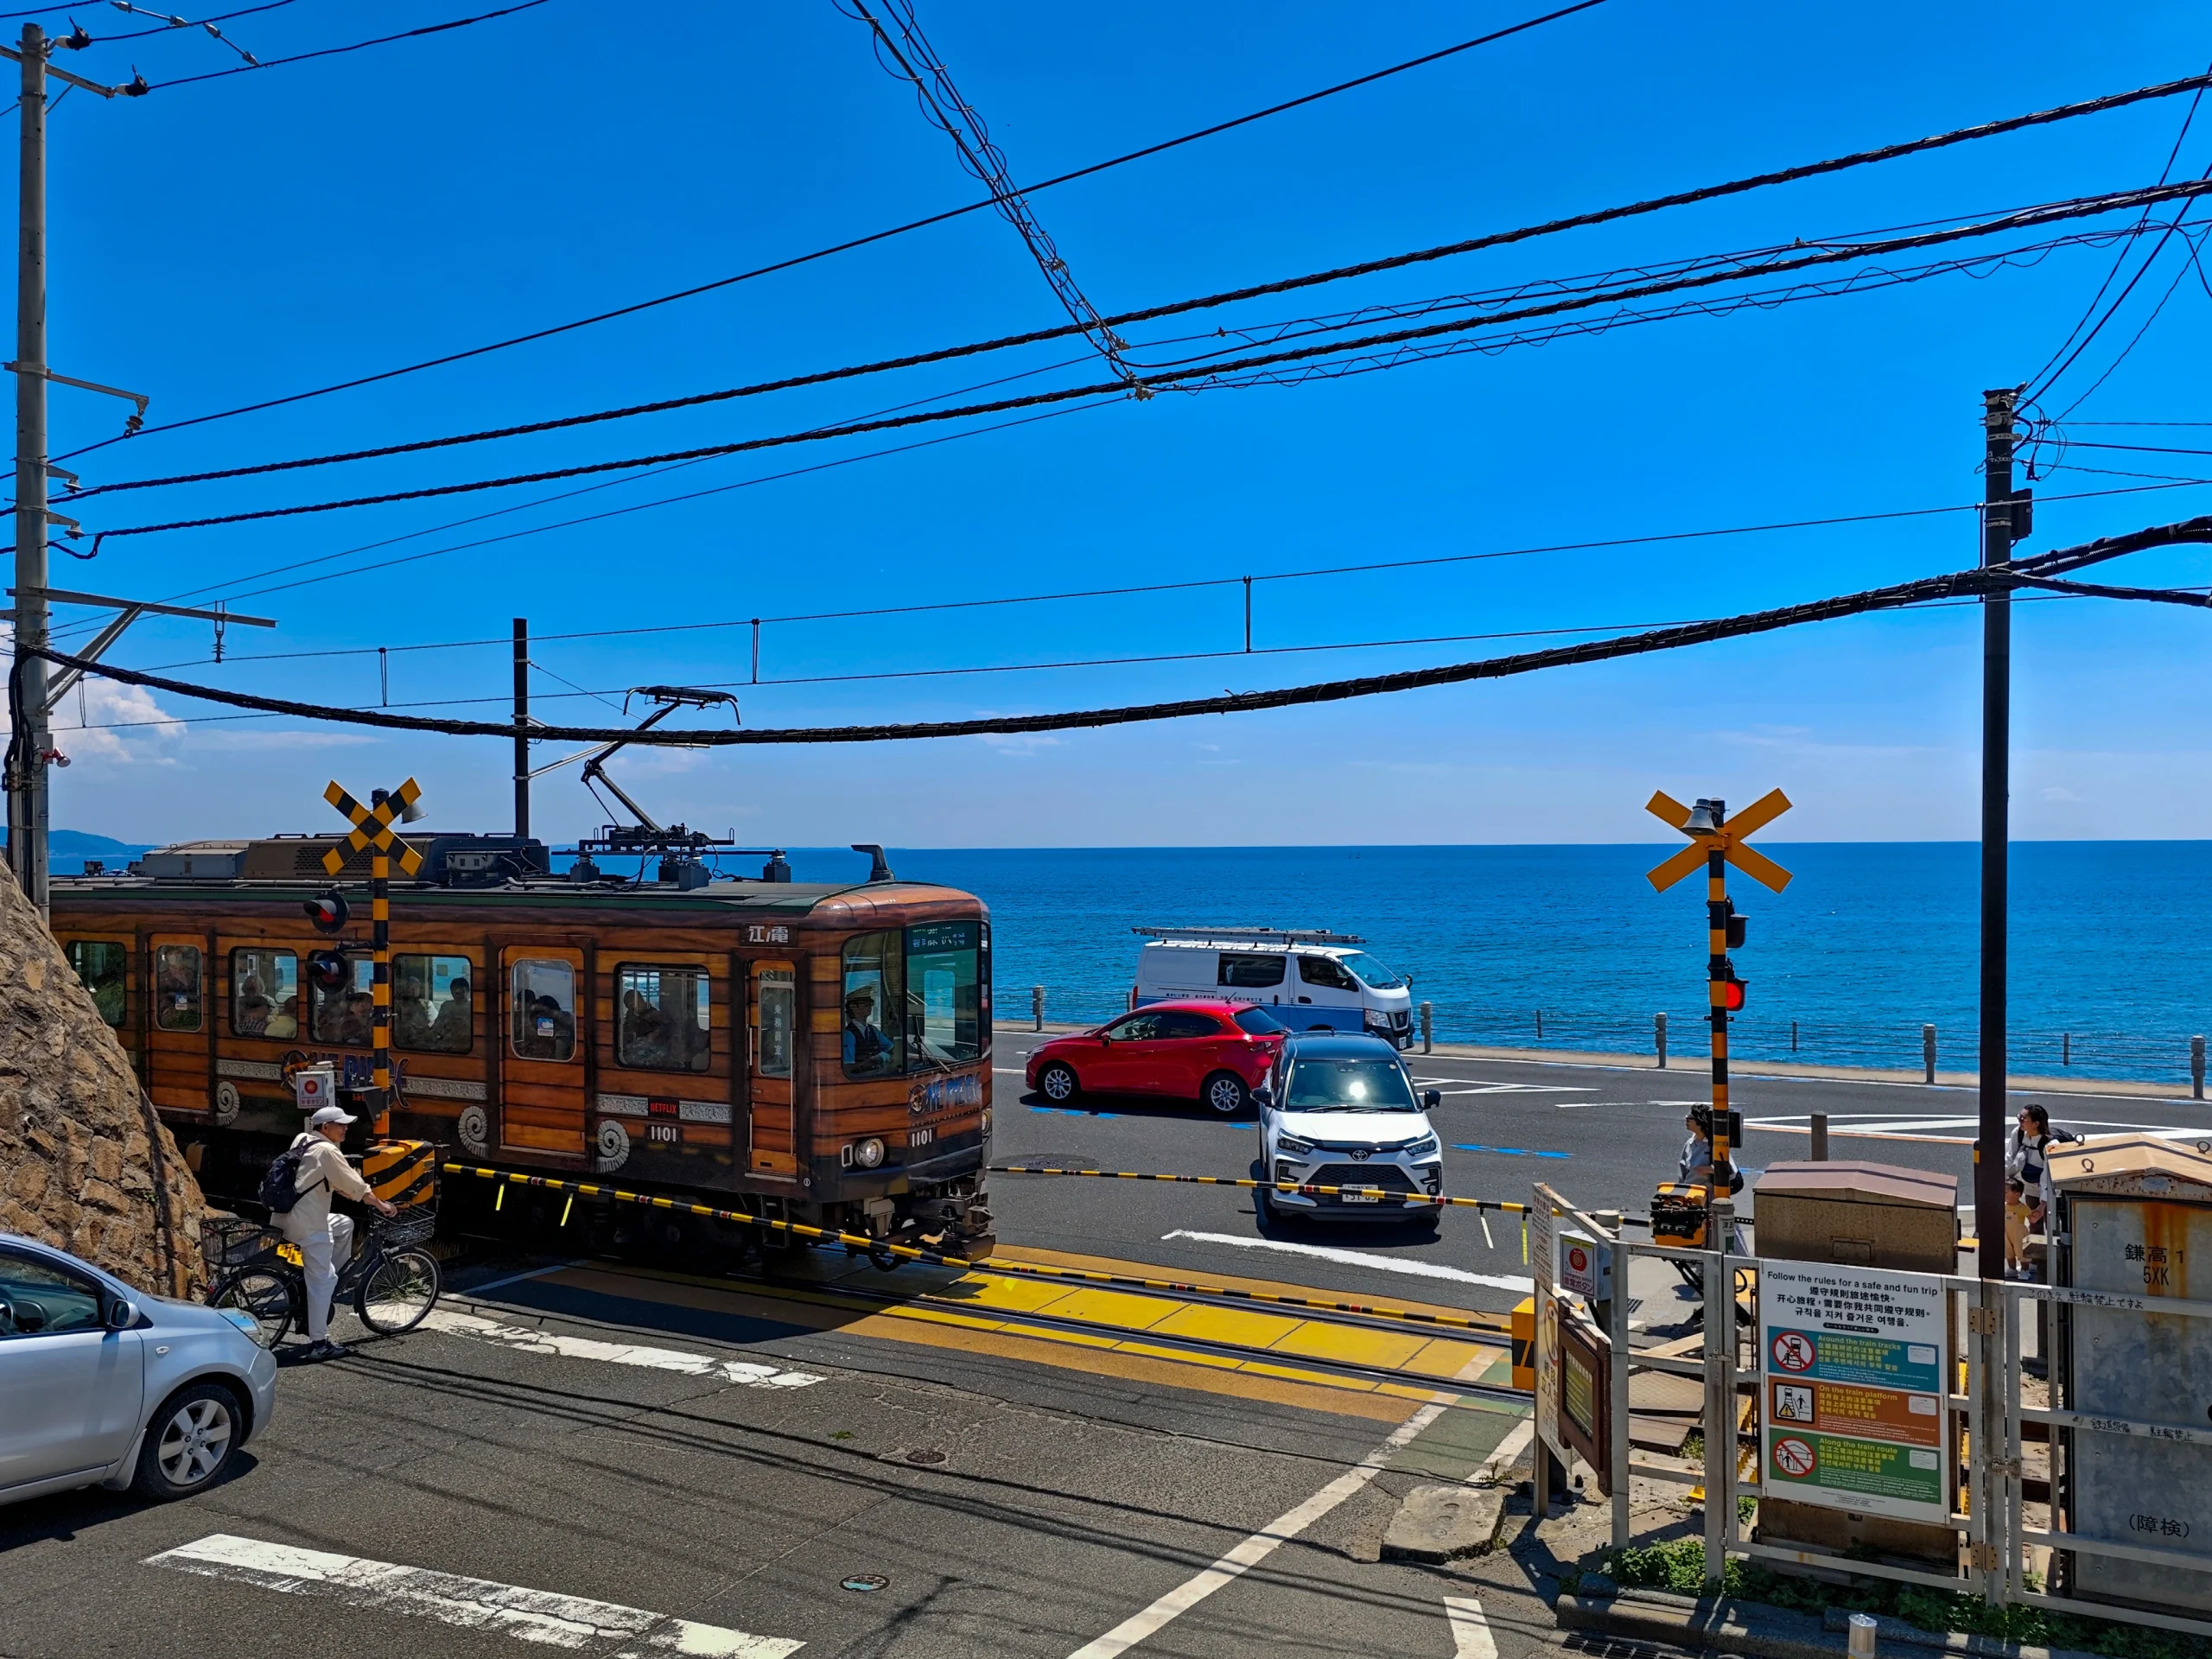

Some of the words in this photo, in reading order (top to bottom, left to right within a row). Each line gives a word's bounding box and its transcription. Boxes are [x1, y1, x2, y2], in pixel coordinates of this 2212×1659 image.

[748, 925, 789, 944] 江ノ電
[651, 1103, 677, 1114] NETFLIX
[651, 1126, 677, 1141] 1101
[912, 1128, 932, 1147] 1101
[1768, 1271, 1795, 1282] Follow
[1798, 1274, 1812, 1283] the
[1815, 1276, 1836, 1286] rules
[1839, 1278, 1852, 1287] for
[1862, 1280, 1881, 1290] safe
[1885, 1282, 1901, 1292] and
[1904, 1284, 1919, 1294] fun
[1922, 1286, 1938, 1297] trip
[2143, 1266, 2170, 1287] 5XK
[1795, 1306, 1822, 1319] 규칙을
[1825, 1310, 1843, 1321] 지켜
[1818, 1335, 1845, 1344] Around
[1878, 1341, 1902, 1351] tracks
[1846, 1389, 1863, 1397] train
[1865, 1390, 1897, 1401] platform
[1819, 1438, 1841, 1447] Along
[1877, 1446, 1898, 1454] route
[2129, 1514, 2190, 1538] (障検)
